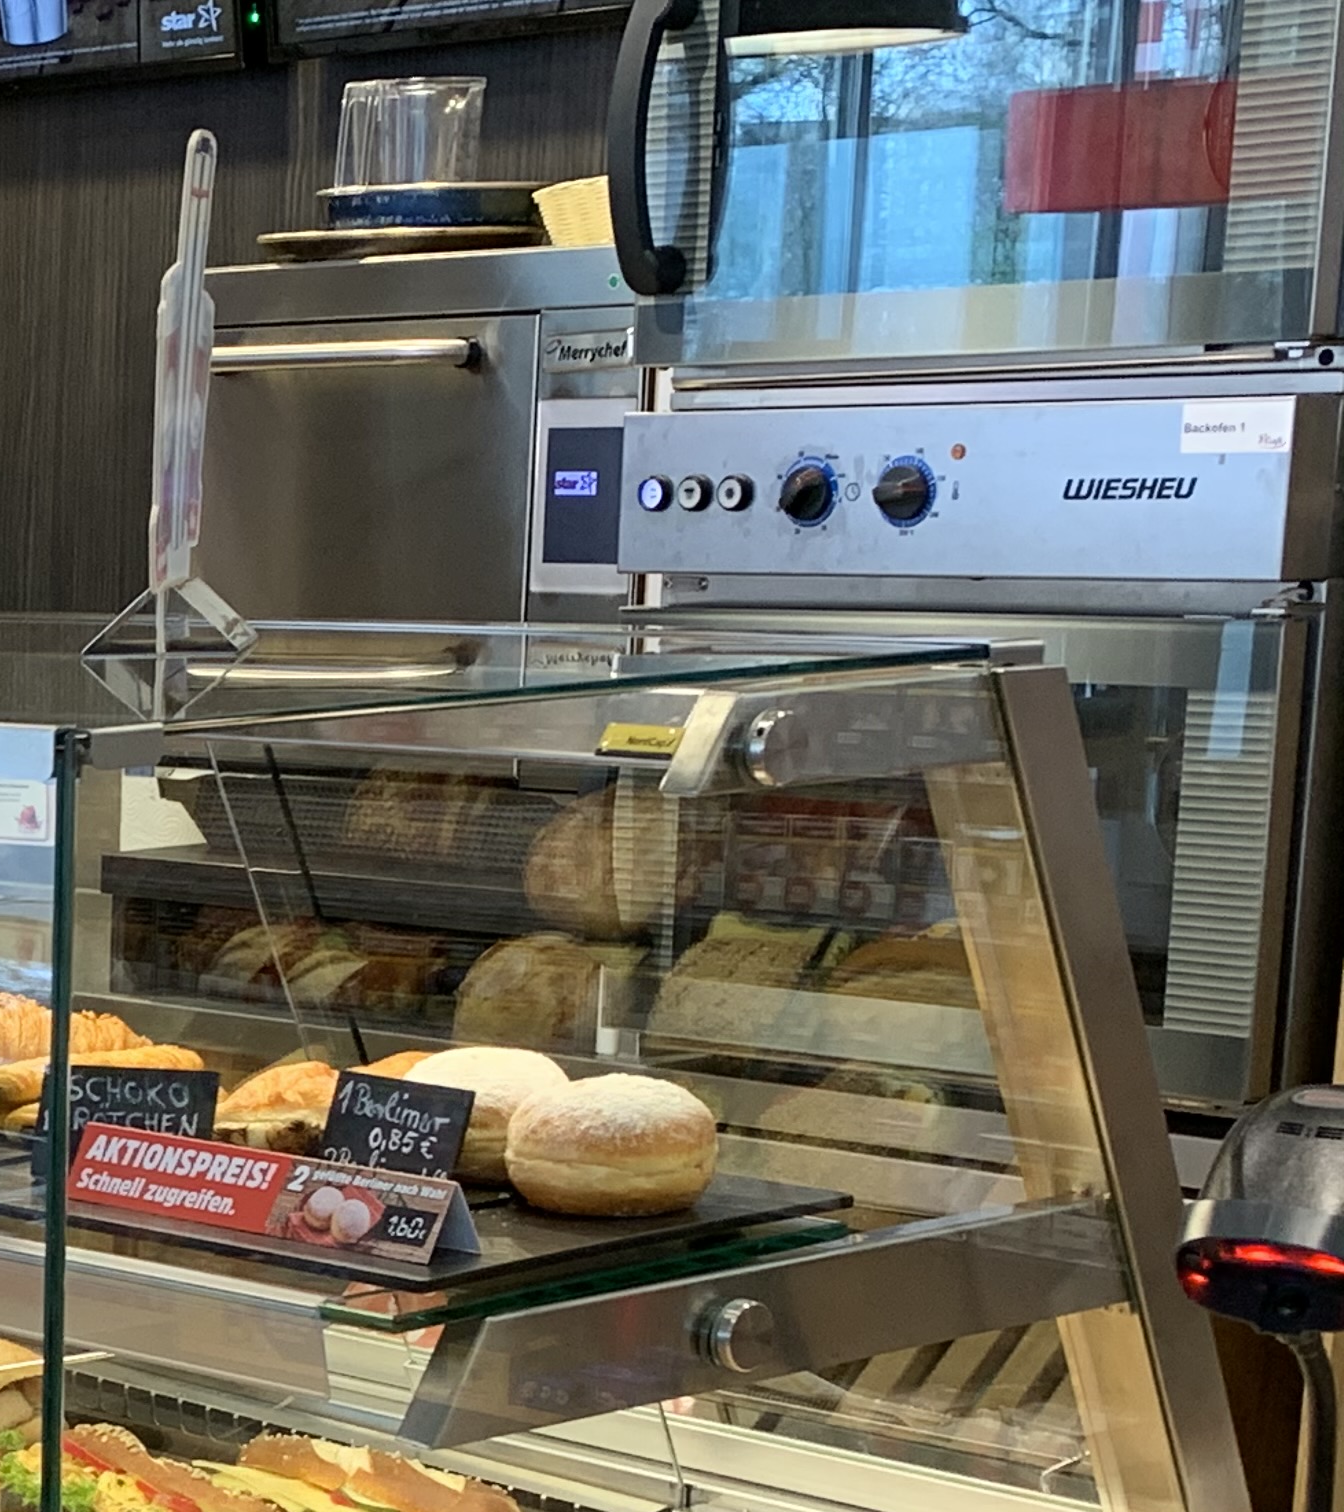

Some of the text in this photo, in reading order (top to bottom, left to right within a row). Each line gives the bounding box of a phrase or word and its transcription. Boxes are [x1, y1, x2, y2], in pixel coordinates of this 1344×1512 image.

[161, 10, 197, 32] star
[558, 339, 627, 363] Merrychef
[1184, 422, 1237, 435] Backofen
[1062, 476, 1198, 501] WIESHEU
[69, 1074, 190, 1110] SCHOKO
[338, 1079, 355, 1115] 1
[42, 1102, 200, 1137] RÖTCHEN
[367, 1126, 438, 1160] 0,85 €
[84, 1133, 279, 1191] AKTIONSPREIS!
[286, 1164, 311, 1192] 2
[352, 1174, 395, 1192] Berliner
[75, 1167, 236, 1216] Schnell zugreifen.
